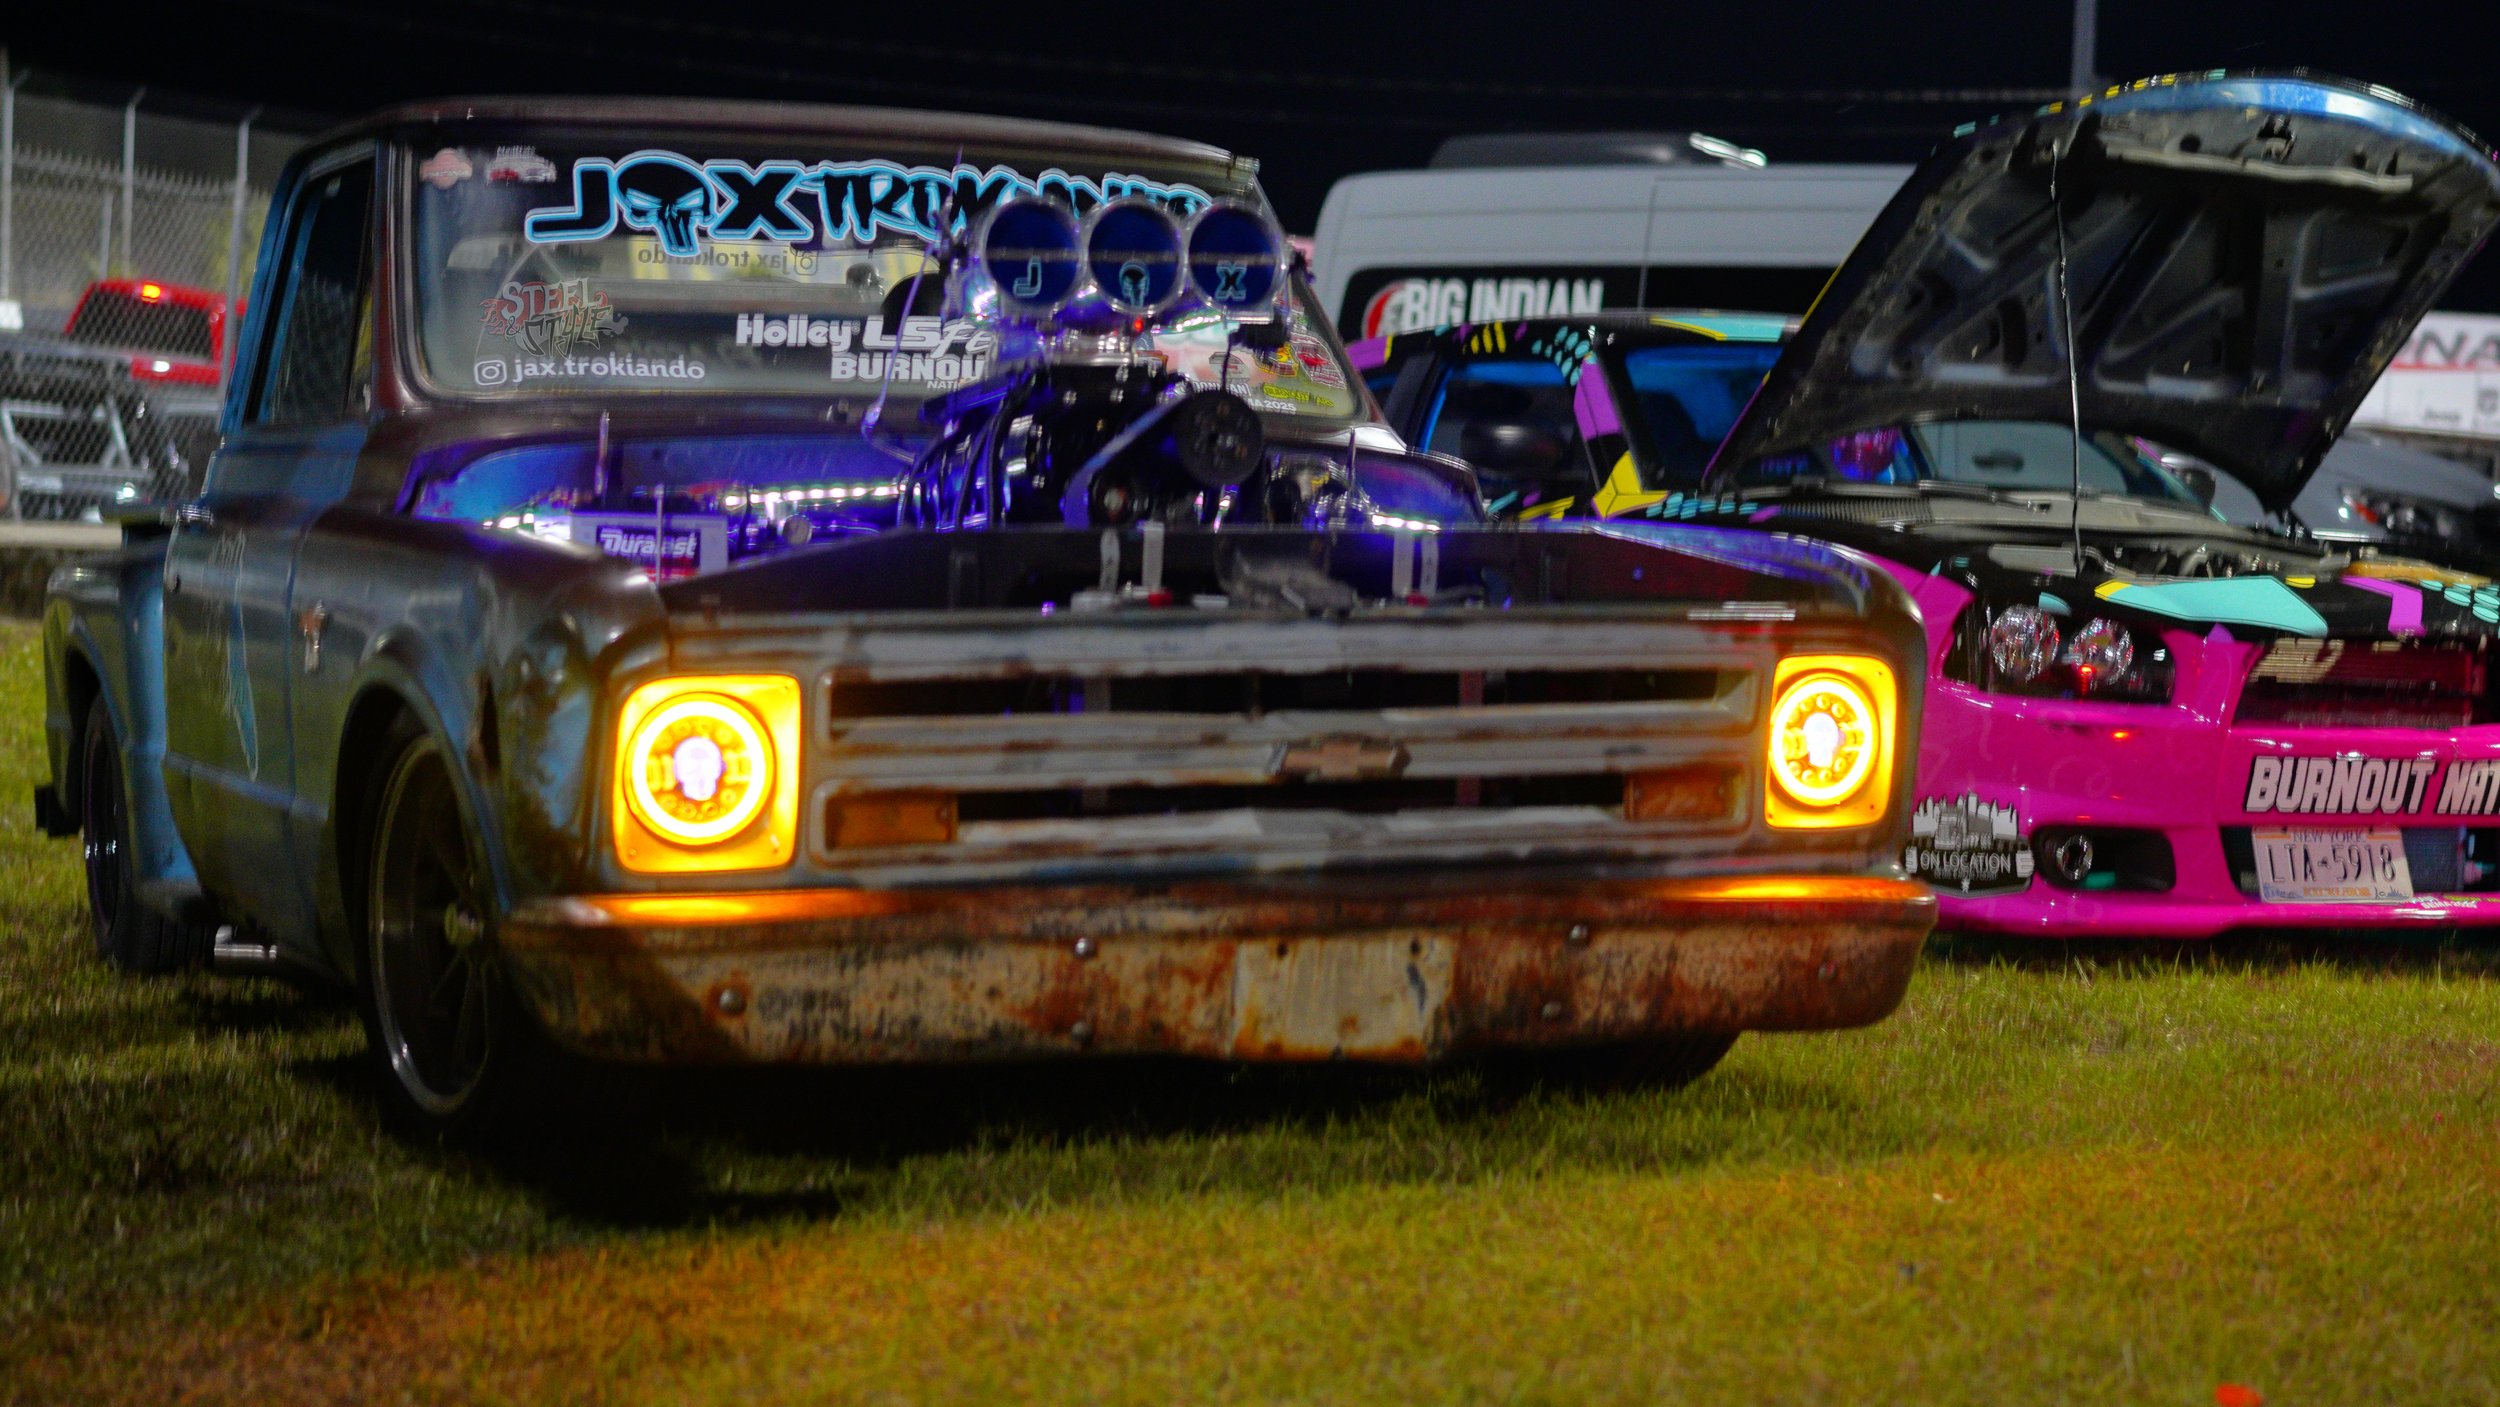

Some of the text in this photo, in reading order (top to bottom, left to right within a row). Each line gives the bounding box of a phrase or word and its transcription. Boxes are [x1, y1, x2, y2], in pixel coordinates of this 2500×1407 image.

[500, 277, 604, 319] STEEL
[1401, 278, 1604, 333] BIG INDIAN
[736, 313, 851, 354] Holley
[512, 351, 706, 384] jax.trokiando
[831, 351, 987, 382] BURNOU
[1264, 400, 1296, 412] 2025
[600, 527, 697, 556] Durast
[2246, 756, 2500, 815] BURNOUT NAT
[2292, 829, 2365, 843] NEW YORK
[1920, 850, 1940, 870] ON
[1943, 850, 2011, 875] LOCATION
